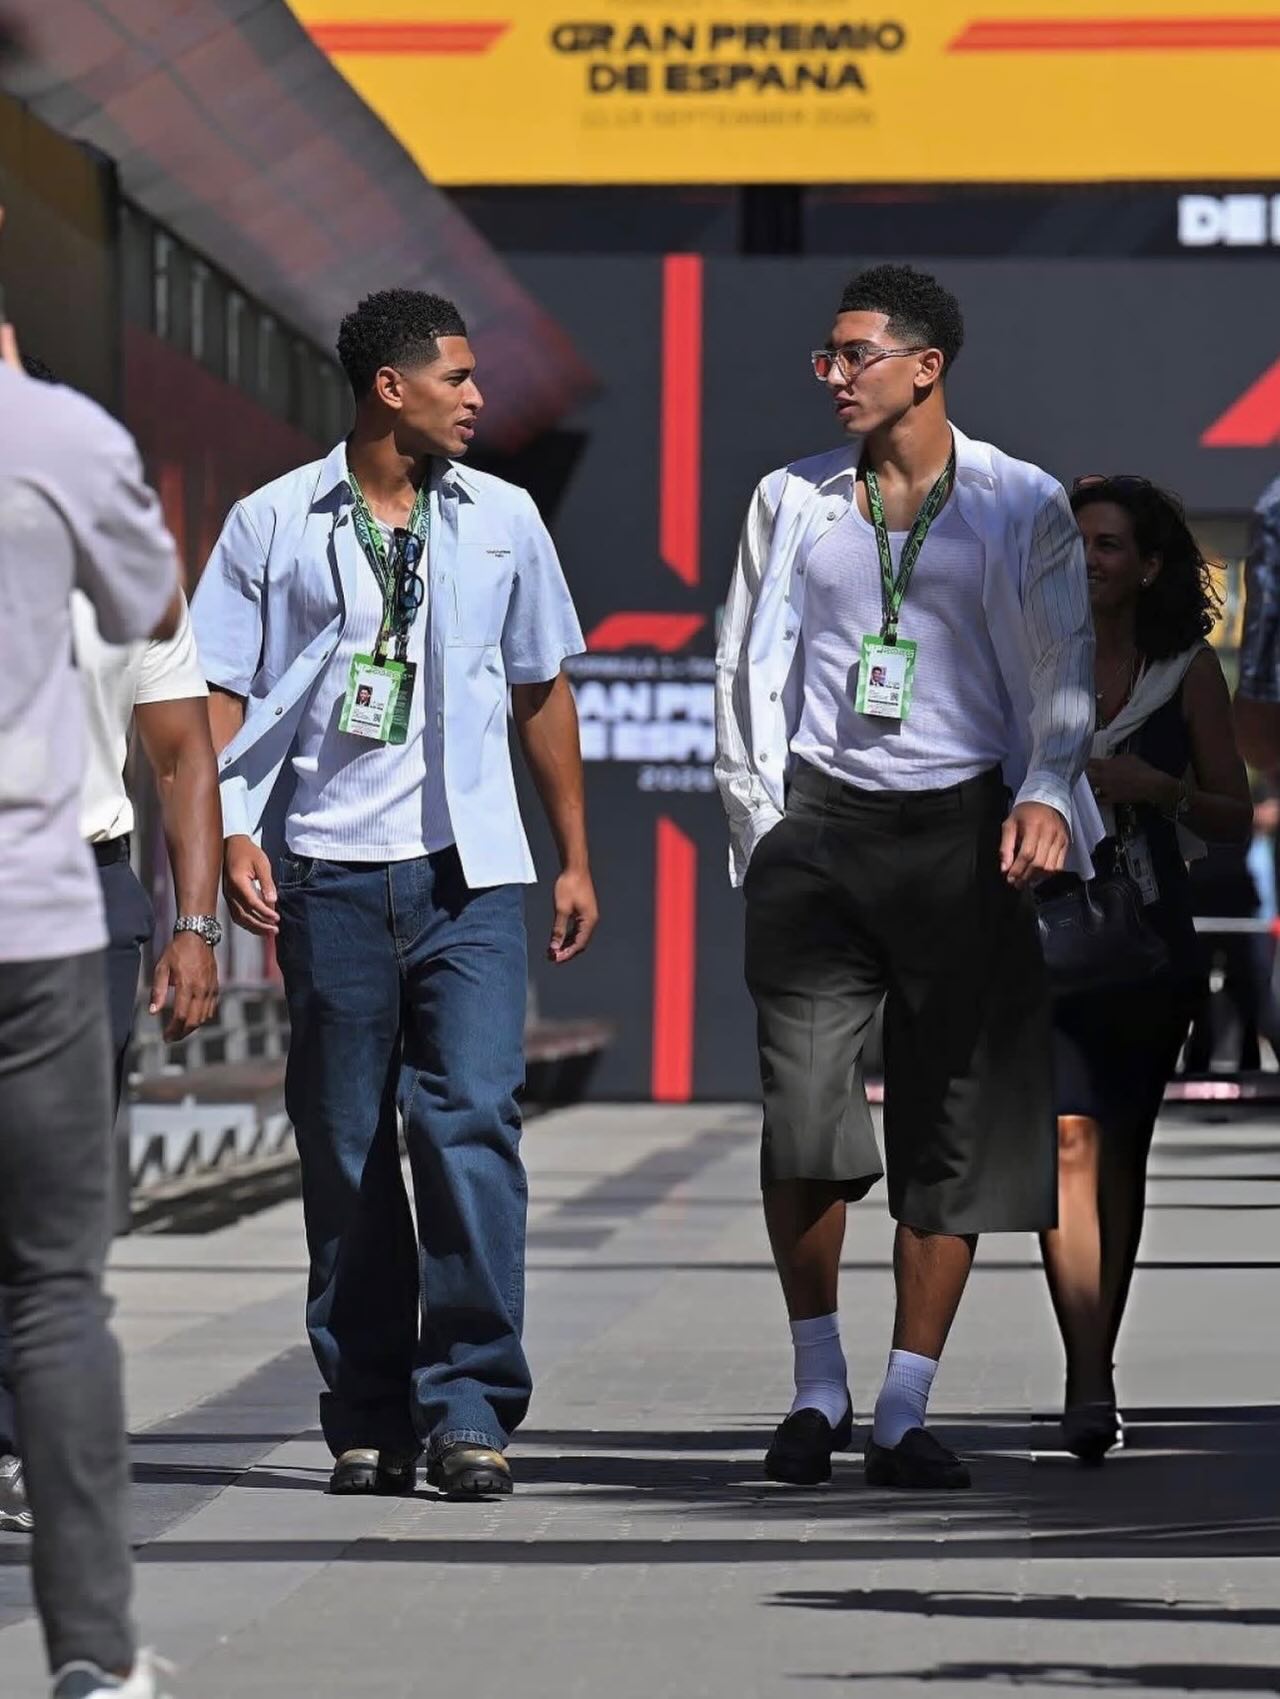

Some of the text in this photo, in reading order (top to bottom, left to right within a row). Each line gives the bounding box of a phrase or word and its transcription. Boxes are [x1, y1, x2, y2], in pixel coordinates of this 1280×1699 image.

[551, 20, 905, 53] GRAN PREMIO
[588, 63, 650, 93] DE
